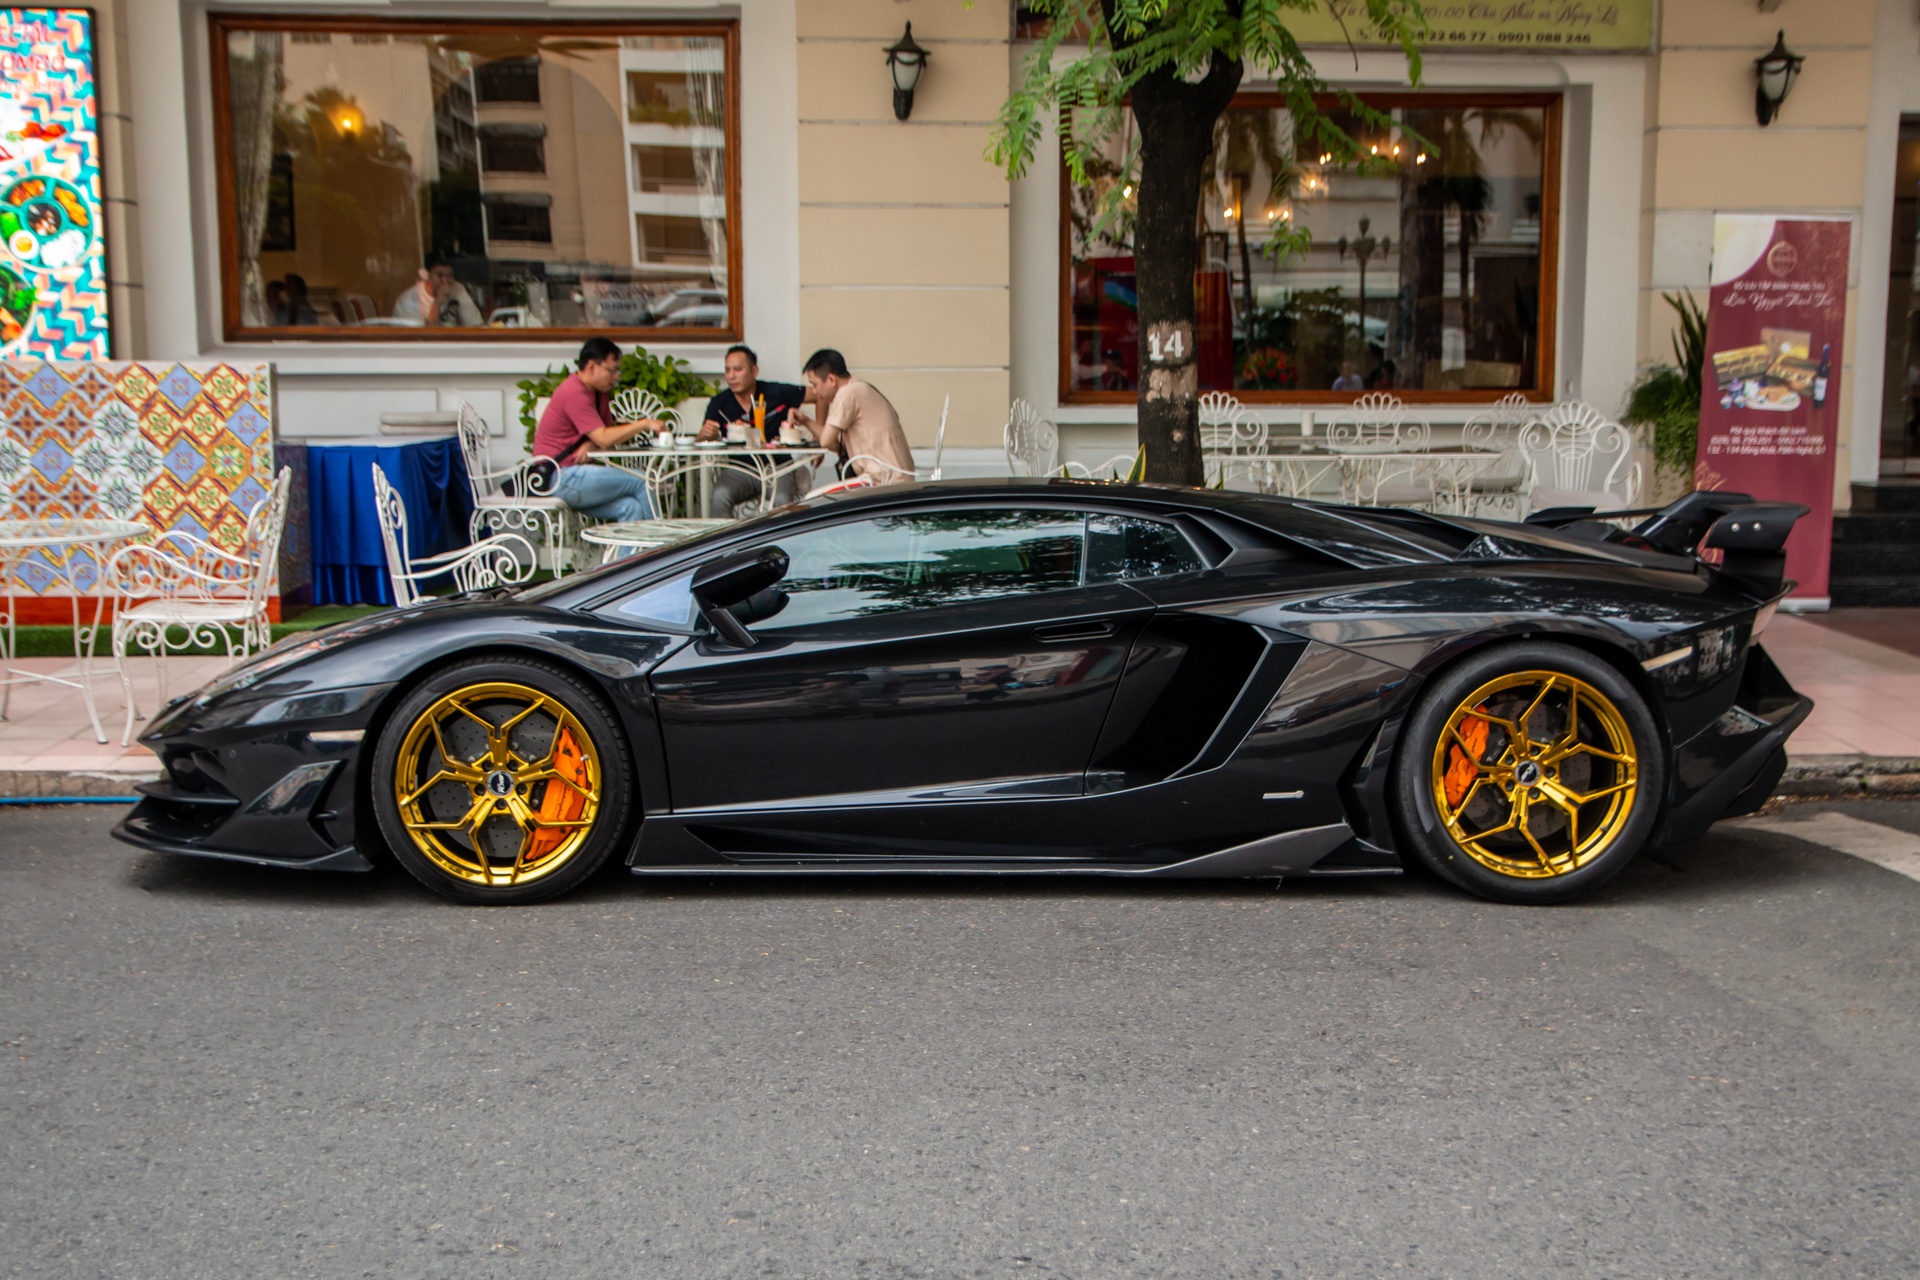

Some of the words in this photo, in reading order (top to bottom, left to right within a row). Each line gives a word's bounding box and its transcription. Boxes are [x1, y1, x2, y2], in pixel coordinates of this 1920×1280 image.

[1498, 31, 1531, 43] 0901
[1535, 32, 1562, 43] 088
[1566, 33, 1592, 44] 246
[1148, 330, 1185, 361] 14
